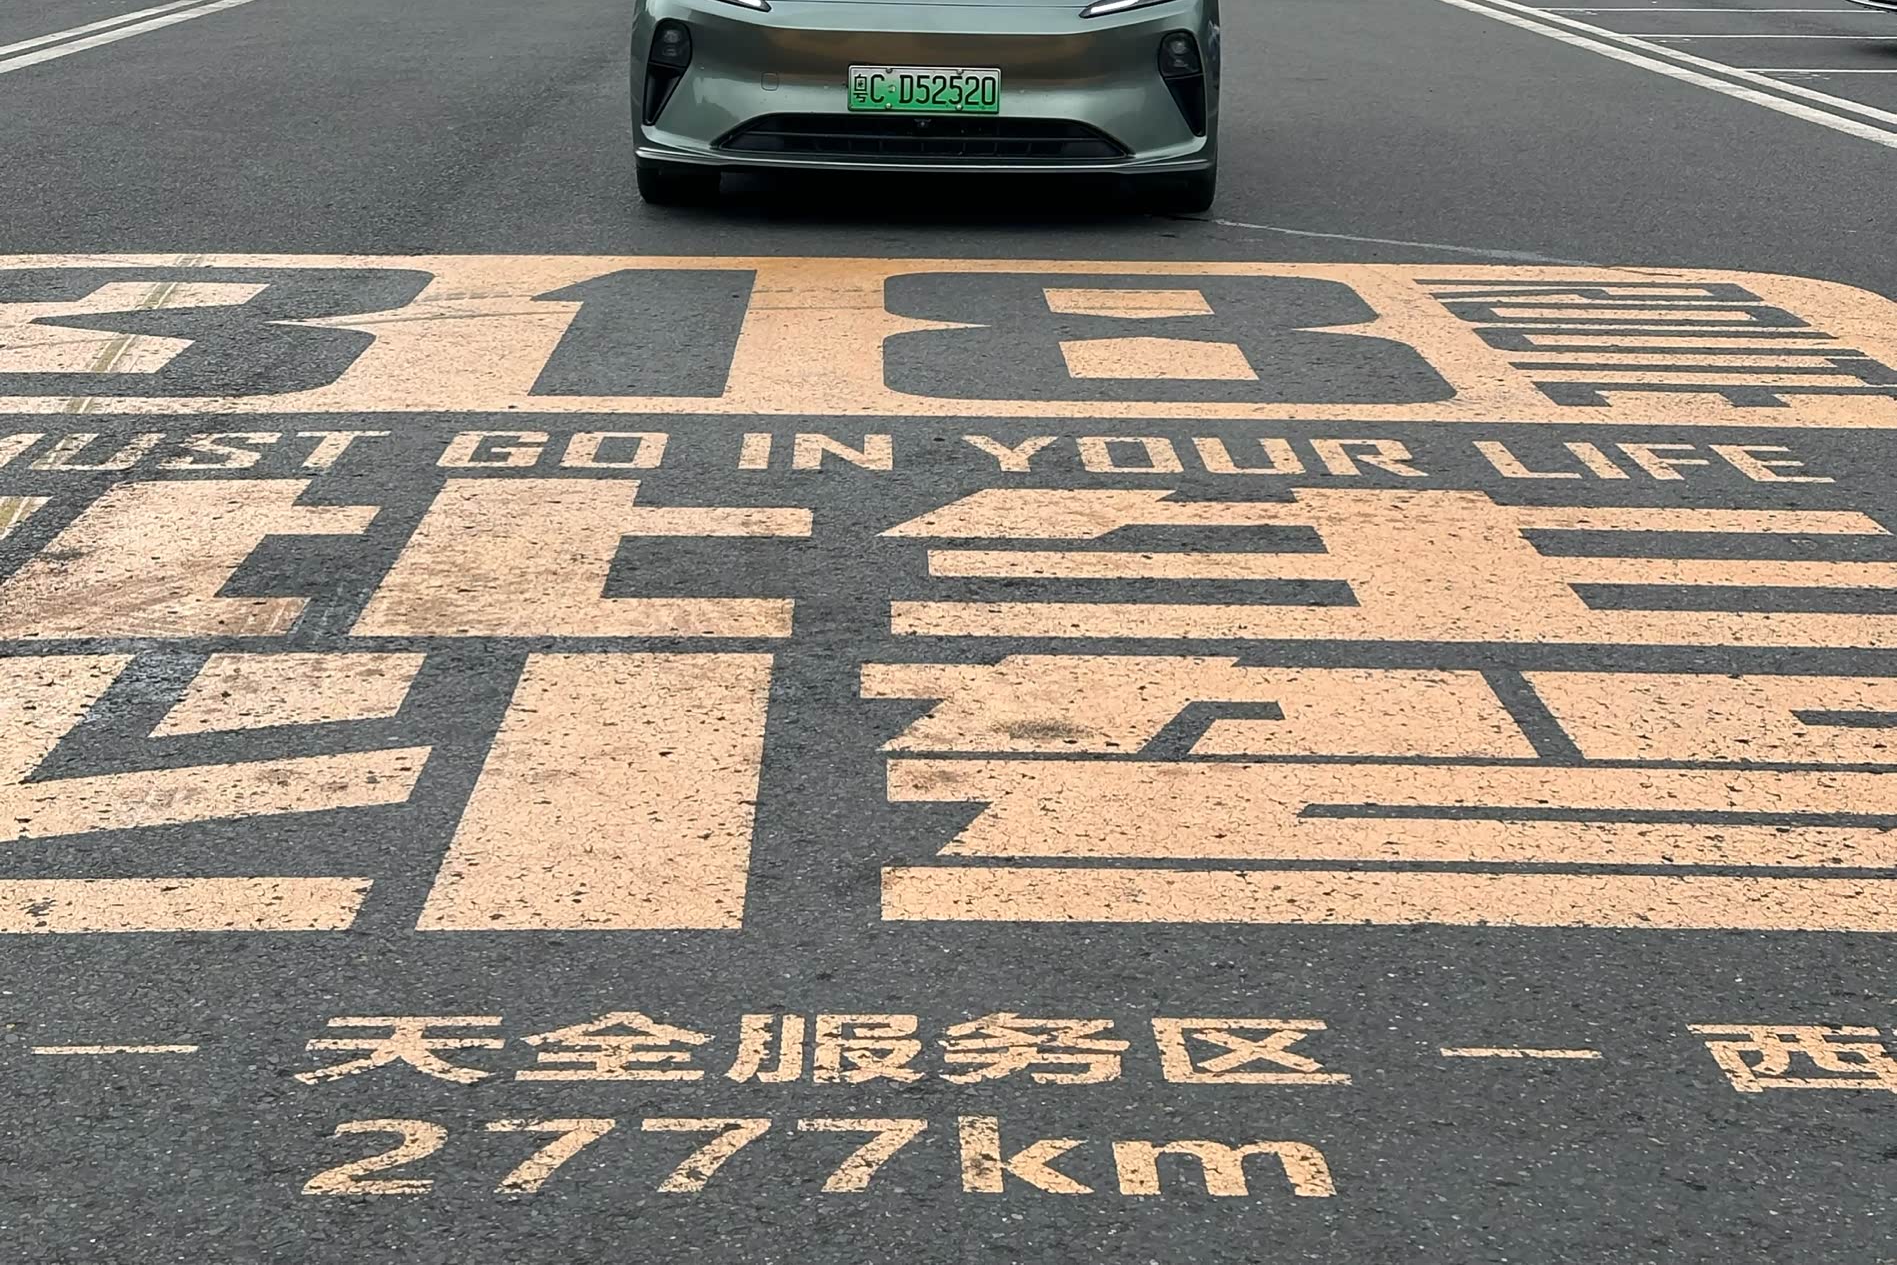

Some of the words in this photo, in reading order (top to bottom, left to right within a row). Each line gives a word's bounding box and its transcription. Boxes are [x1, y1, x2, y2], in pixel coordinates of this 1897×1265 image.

[0, 266, 1458, 406] 318
[436, 431, 670, 469] GO
[737, 432, 895, 470] IN
[962, 434, 1429, 477] YOUR
[1471, 440, 1837, 483] LIFE
[293, 1010, 1353, 1086] 天全服务区
[300, 1115, 1337, 1198] 2777km
